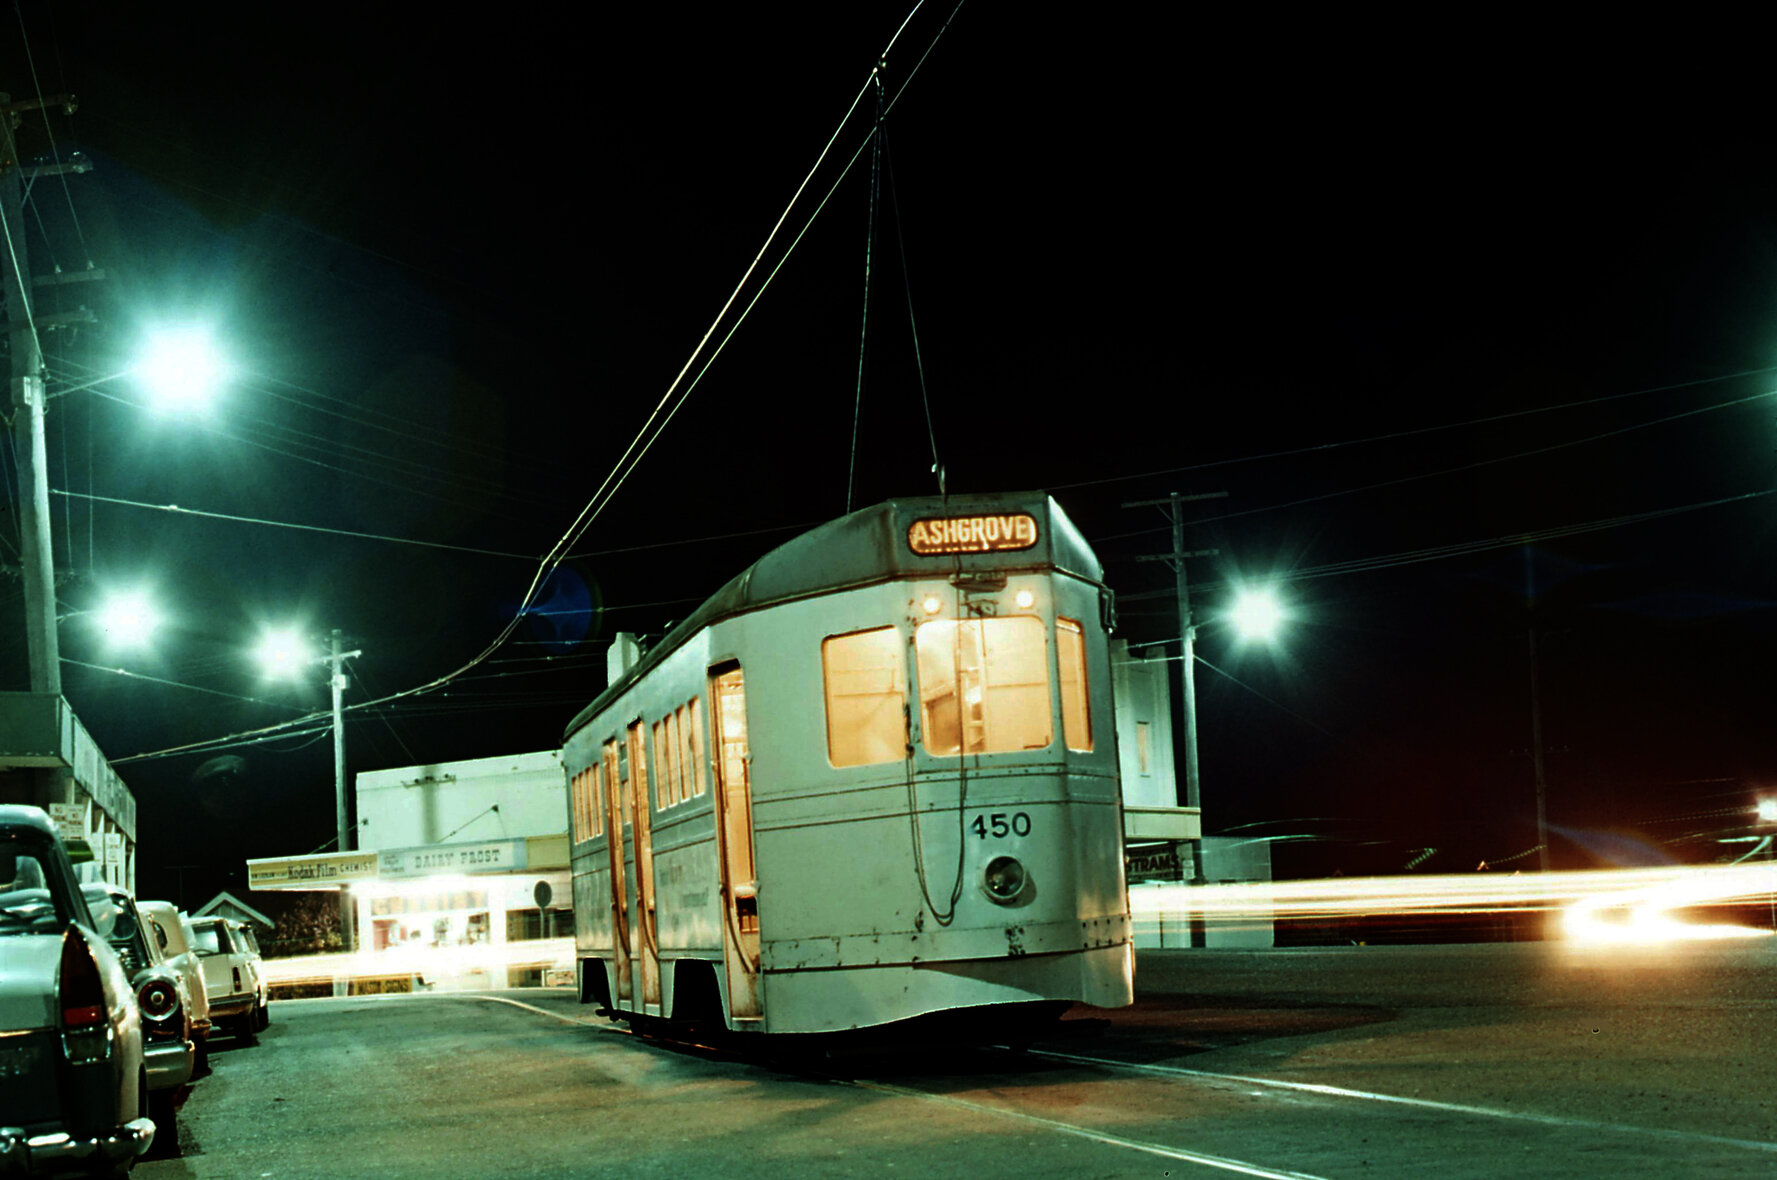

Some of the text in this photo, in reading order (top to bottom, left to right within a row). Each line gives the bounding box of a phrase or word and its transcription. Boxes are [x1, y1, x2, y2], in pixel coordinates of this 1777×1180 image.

[913, 515, 1027, 545] ASHGROVE
[970, 811, 1032, 840] 450
[340, 861, 373, 873] CHEMIST
[415, 852, 454, 869] DAIRY
[460, 848, 499, 865] FROST
[288, 864, 315, 880] Kodak
[316, 863, 337, 878] Film
